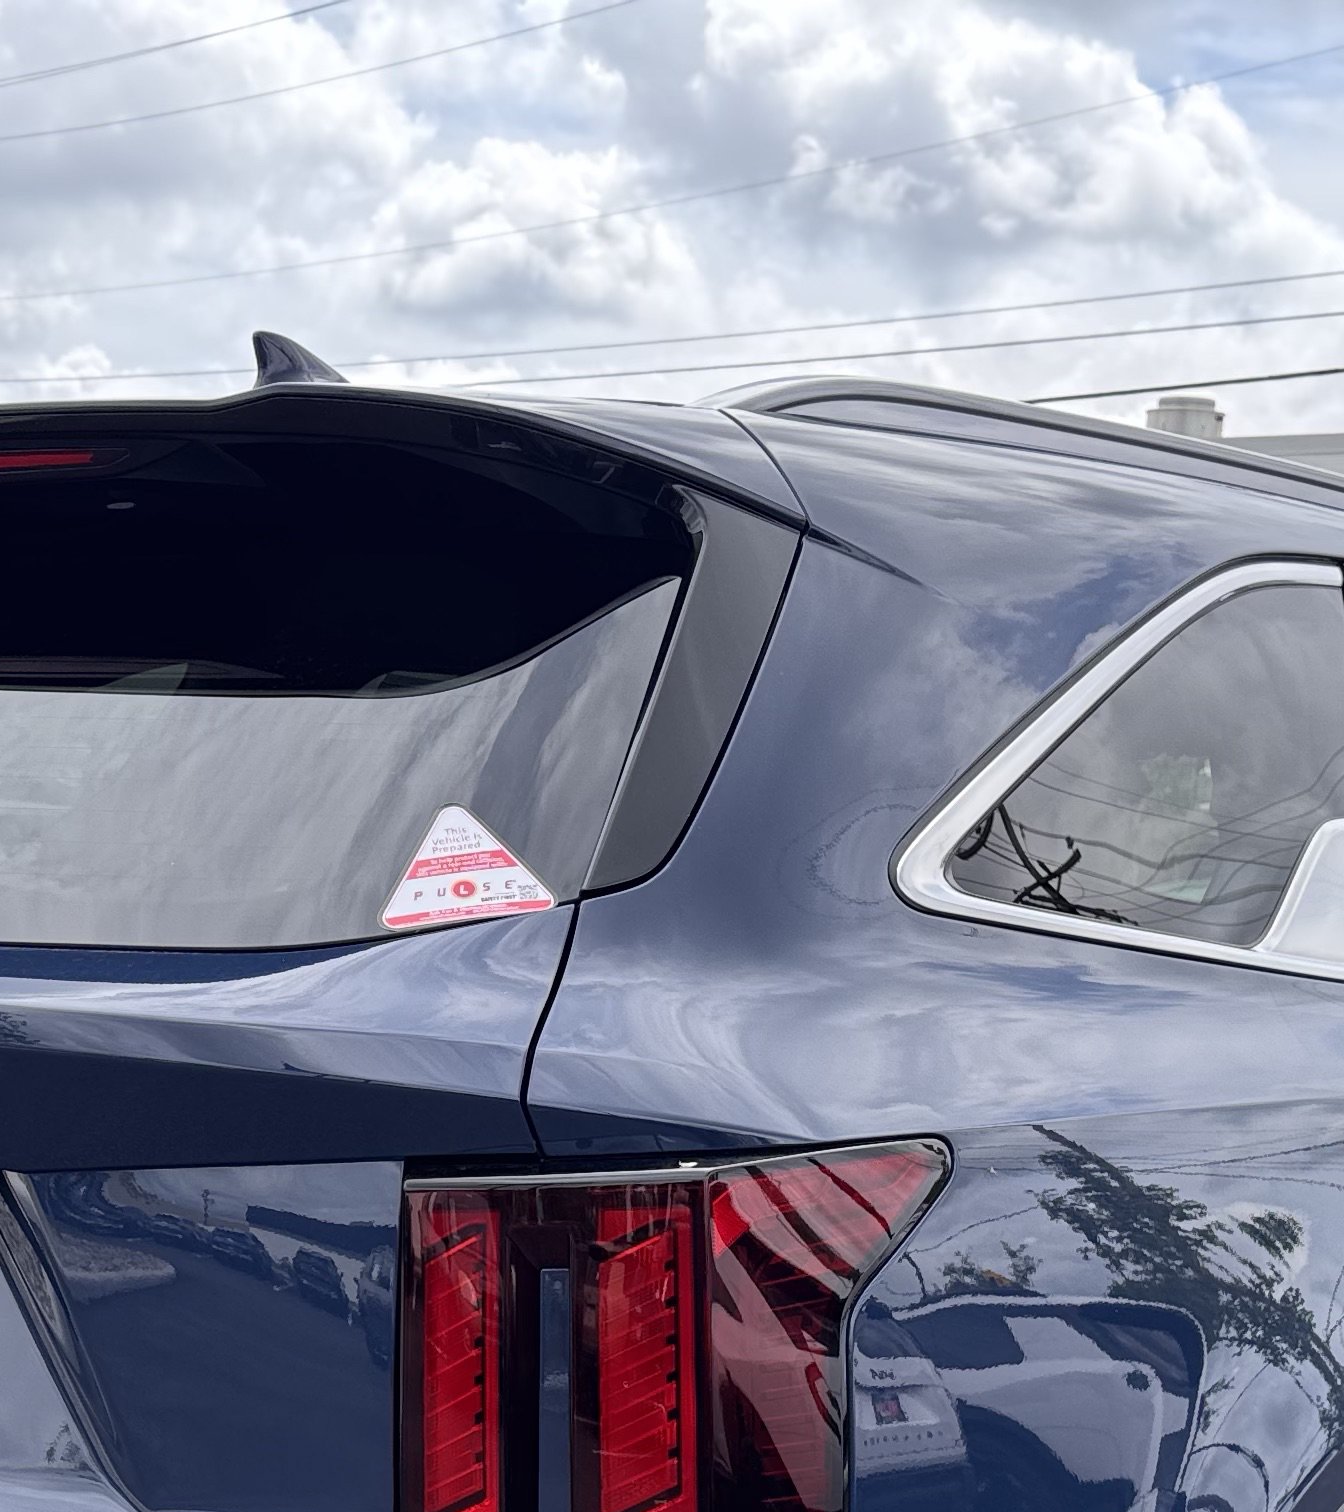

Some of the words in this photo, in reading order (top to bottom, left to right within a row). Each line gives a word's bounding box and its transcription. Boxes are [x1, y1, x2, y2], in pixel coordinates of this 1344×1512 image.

[432, 837, 471, 846] Vehicle
[431, 842, 481, 854] Prepared
[414, 879, 516, 901] PULSE
